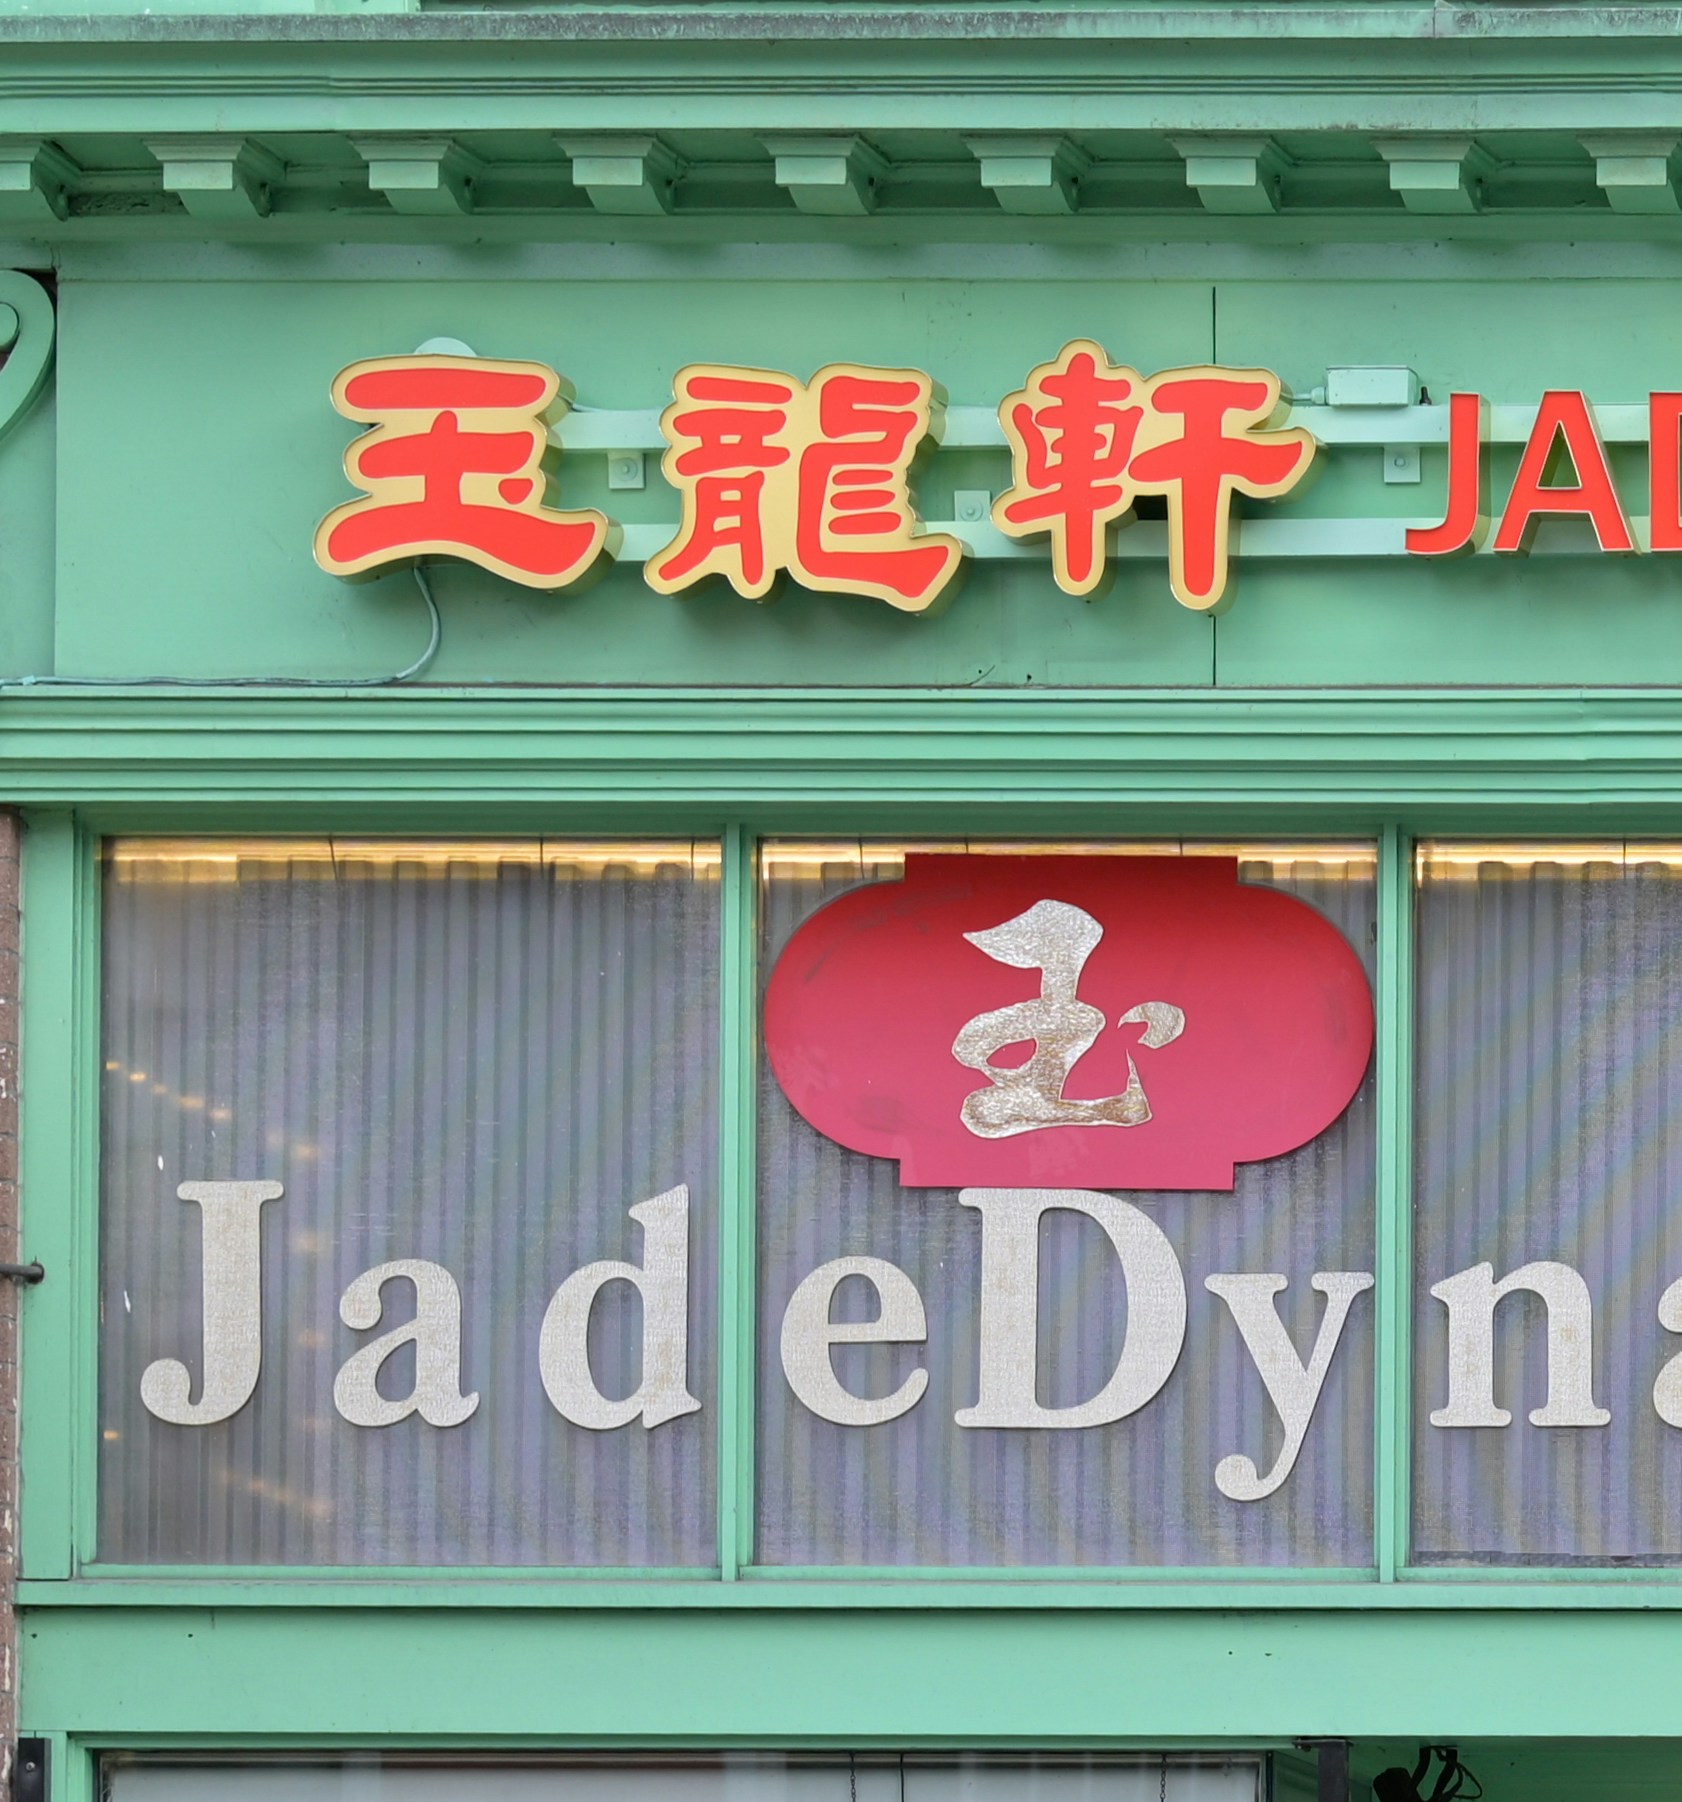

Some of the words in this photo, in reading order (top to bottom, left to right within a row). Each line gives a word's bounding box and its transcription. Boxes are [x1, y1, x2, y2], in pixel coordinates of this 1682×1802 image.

[316, 345, 1314, 611] 玉龍軒
[951, 897, 1187, 1140] 玉
